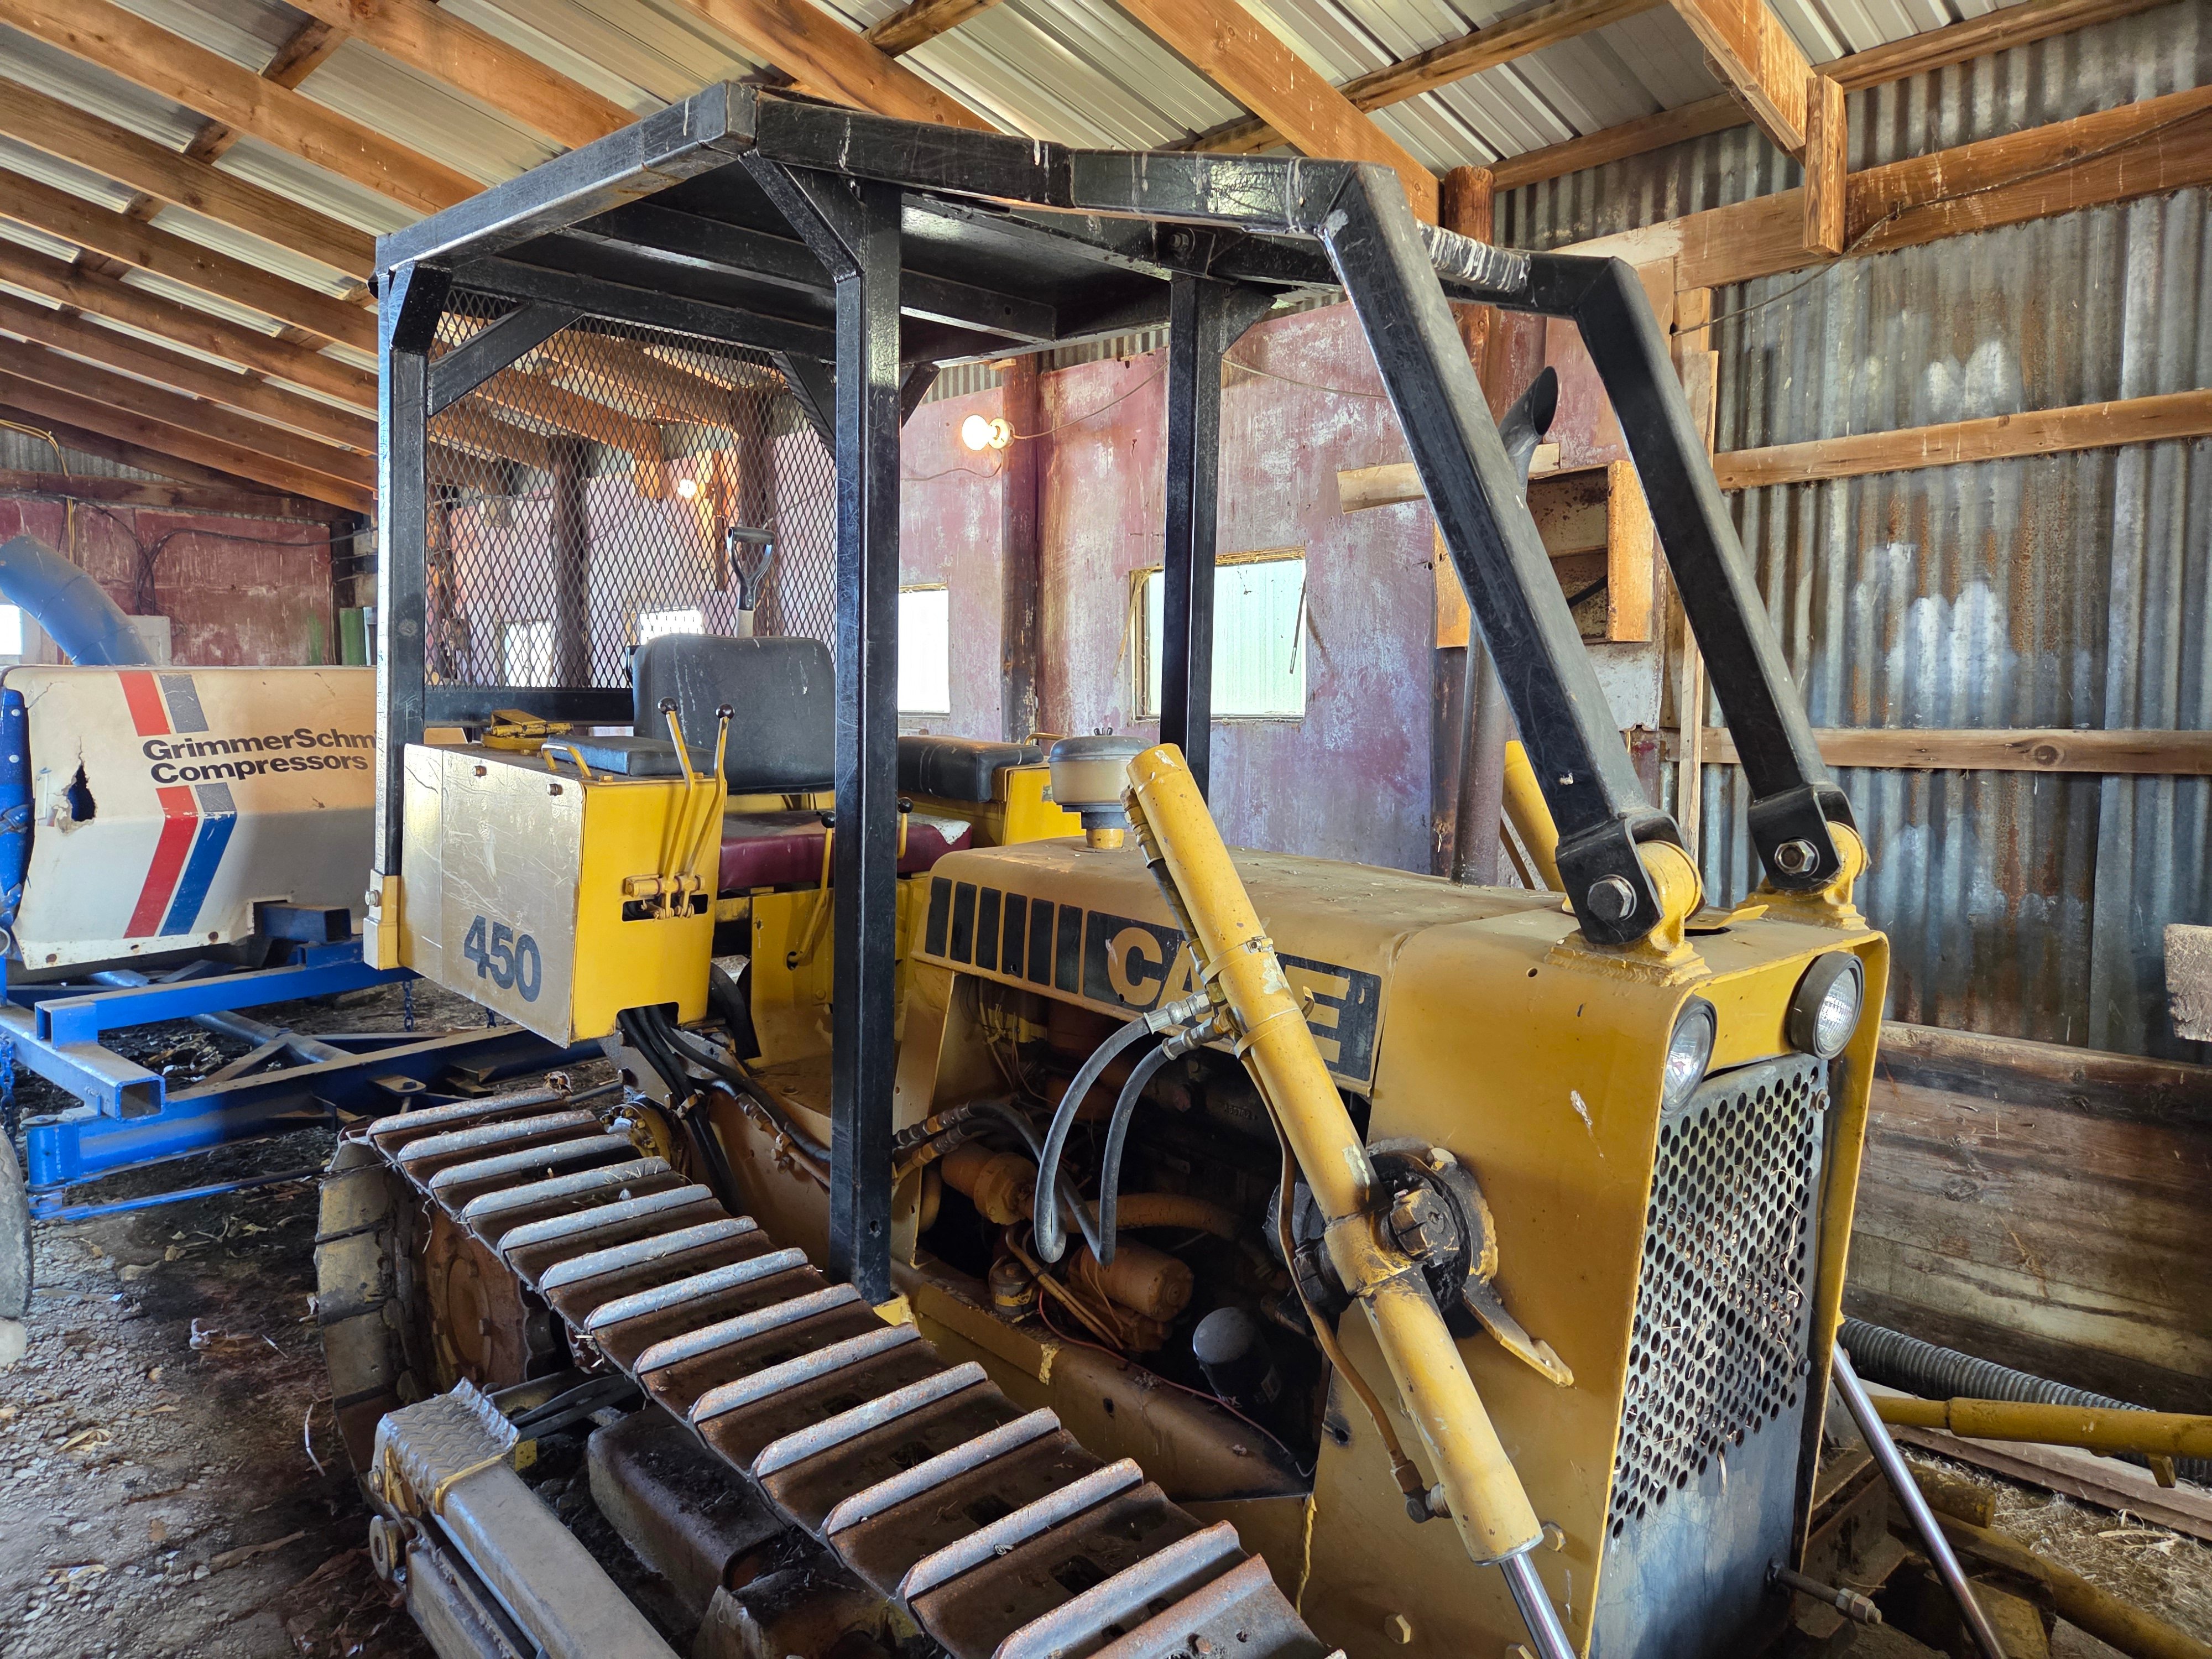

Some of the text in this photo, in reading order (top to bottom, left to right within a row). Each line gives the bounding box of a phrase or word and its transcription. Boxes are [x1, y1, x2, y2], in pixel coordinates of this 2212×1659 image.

[143, 728, 377, 760] GrimmerSchm
[151, 755, 368, 784] Compressors
[464, 915, 541, 1002] 450
[1108, 927, 1350, 1064] CAE
